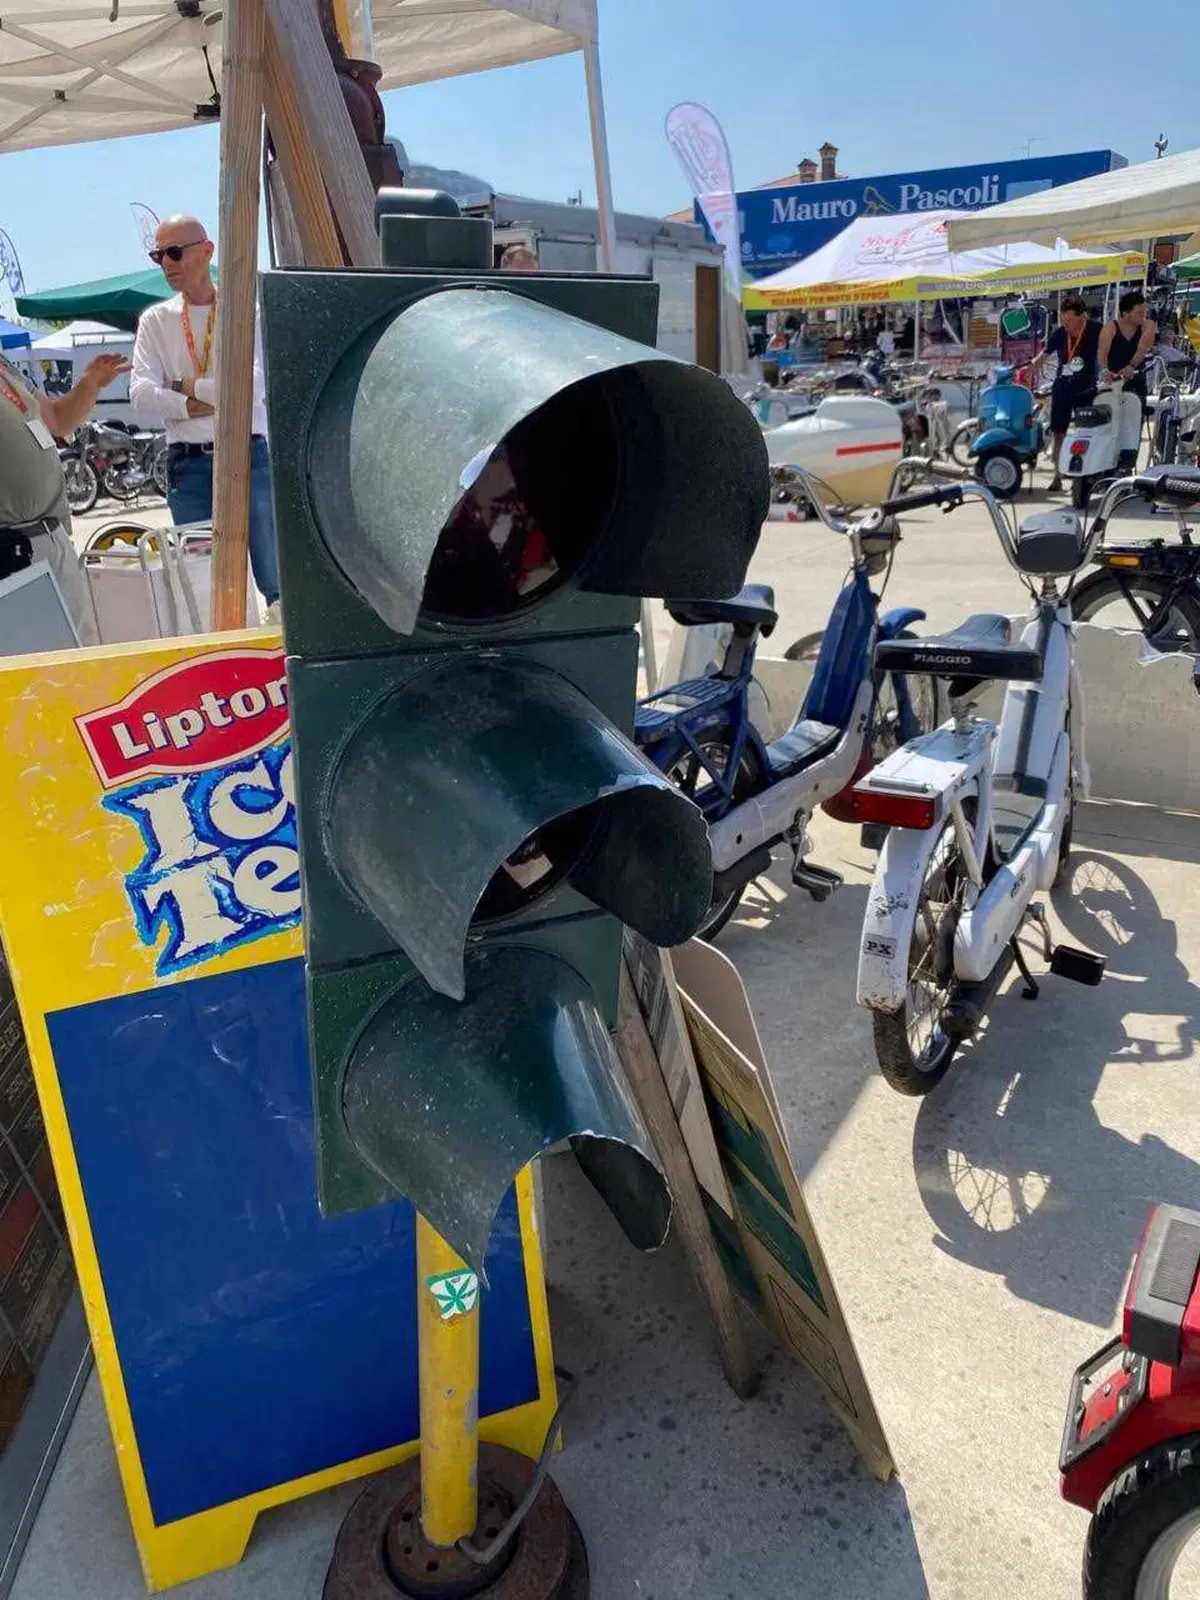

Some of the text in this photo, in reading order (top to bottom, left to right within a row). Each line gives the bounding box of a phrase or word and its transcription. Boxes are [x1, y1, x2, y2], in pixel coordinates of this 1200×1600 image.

[771, 197, 857, 223] Mauro
[899, 175, 999, 212] Pascoli
[912, 653, 972, 665] PIAGGIO
[143, 845, 301, 958] Te
[866, 940, 892, 956] PX
